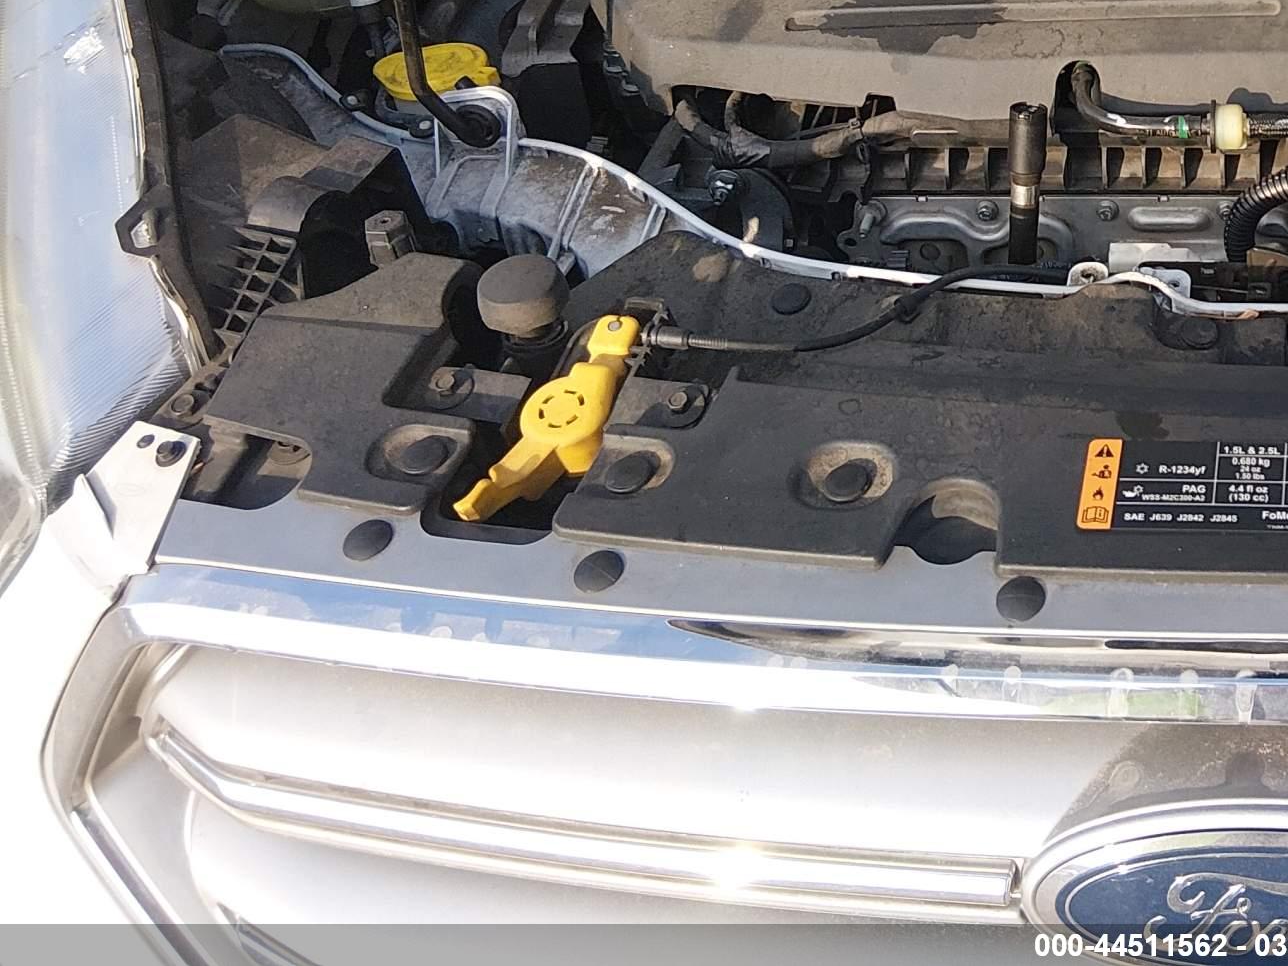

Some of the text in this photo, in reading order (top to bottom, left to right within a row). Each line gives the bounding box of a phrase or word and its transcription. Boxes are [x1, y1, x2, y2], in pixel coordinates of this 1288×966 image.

[1223, 445, 1280, 455] 1.5L & 2.5L
[1231, 457, 1271, 468] 0.680 kg
[1158, 464, 1206, 476] R-1234yf
[1235, 472, 1265, 480] 1.50 lbs
[1181, 484, 1206, 494] PAG
[1228, 484, 1268, 494] 4.4 fl oz
[1228, 493, 1269, 503] (130 cc)
[1123, 513, 1145, 522] SAE
[1149, 513, 1173, 522] J639
[1176, 514, 1205, 522] J2842
